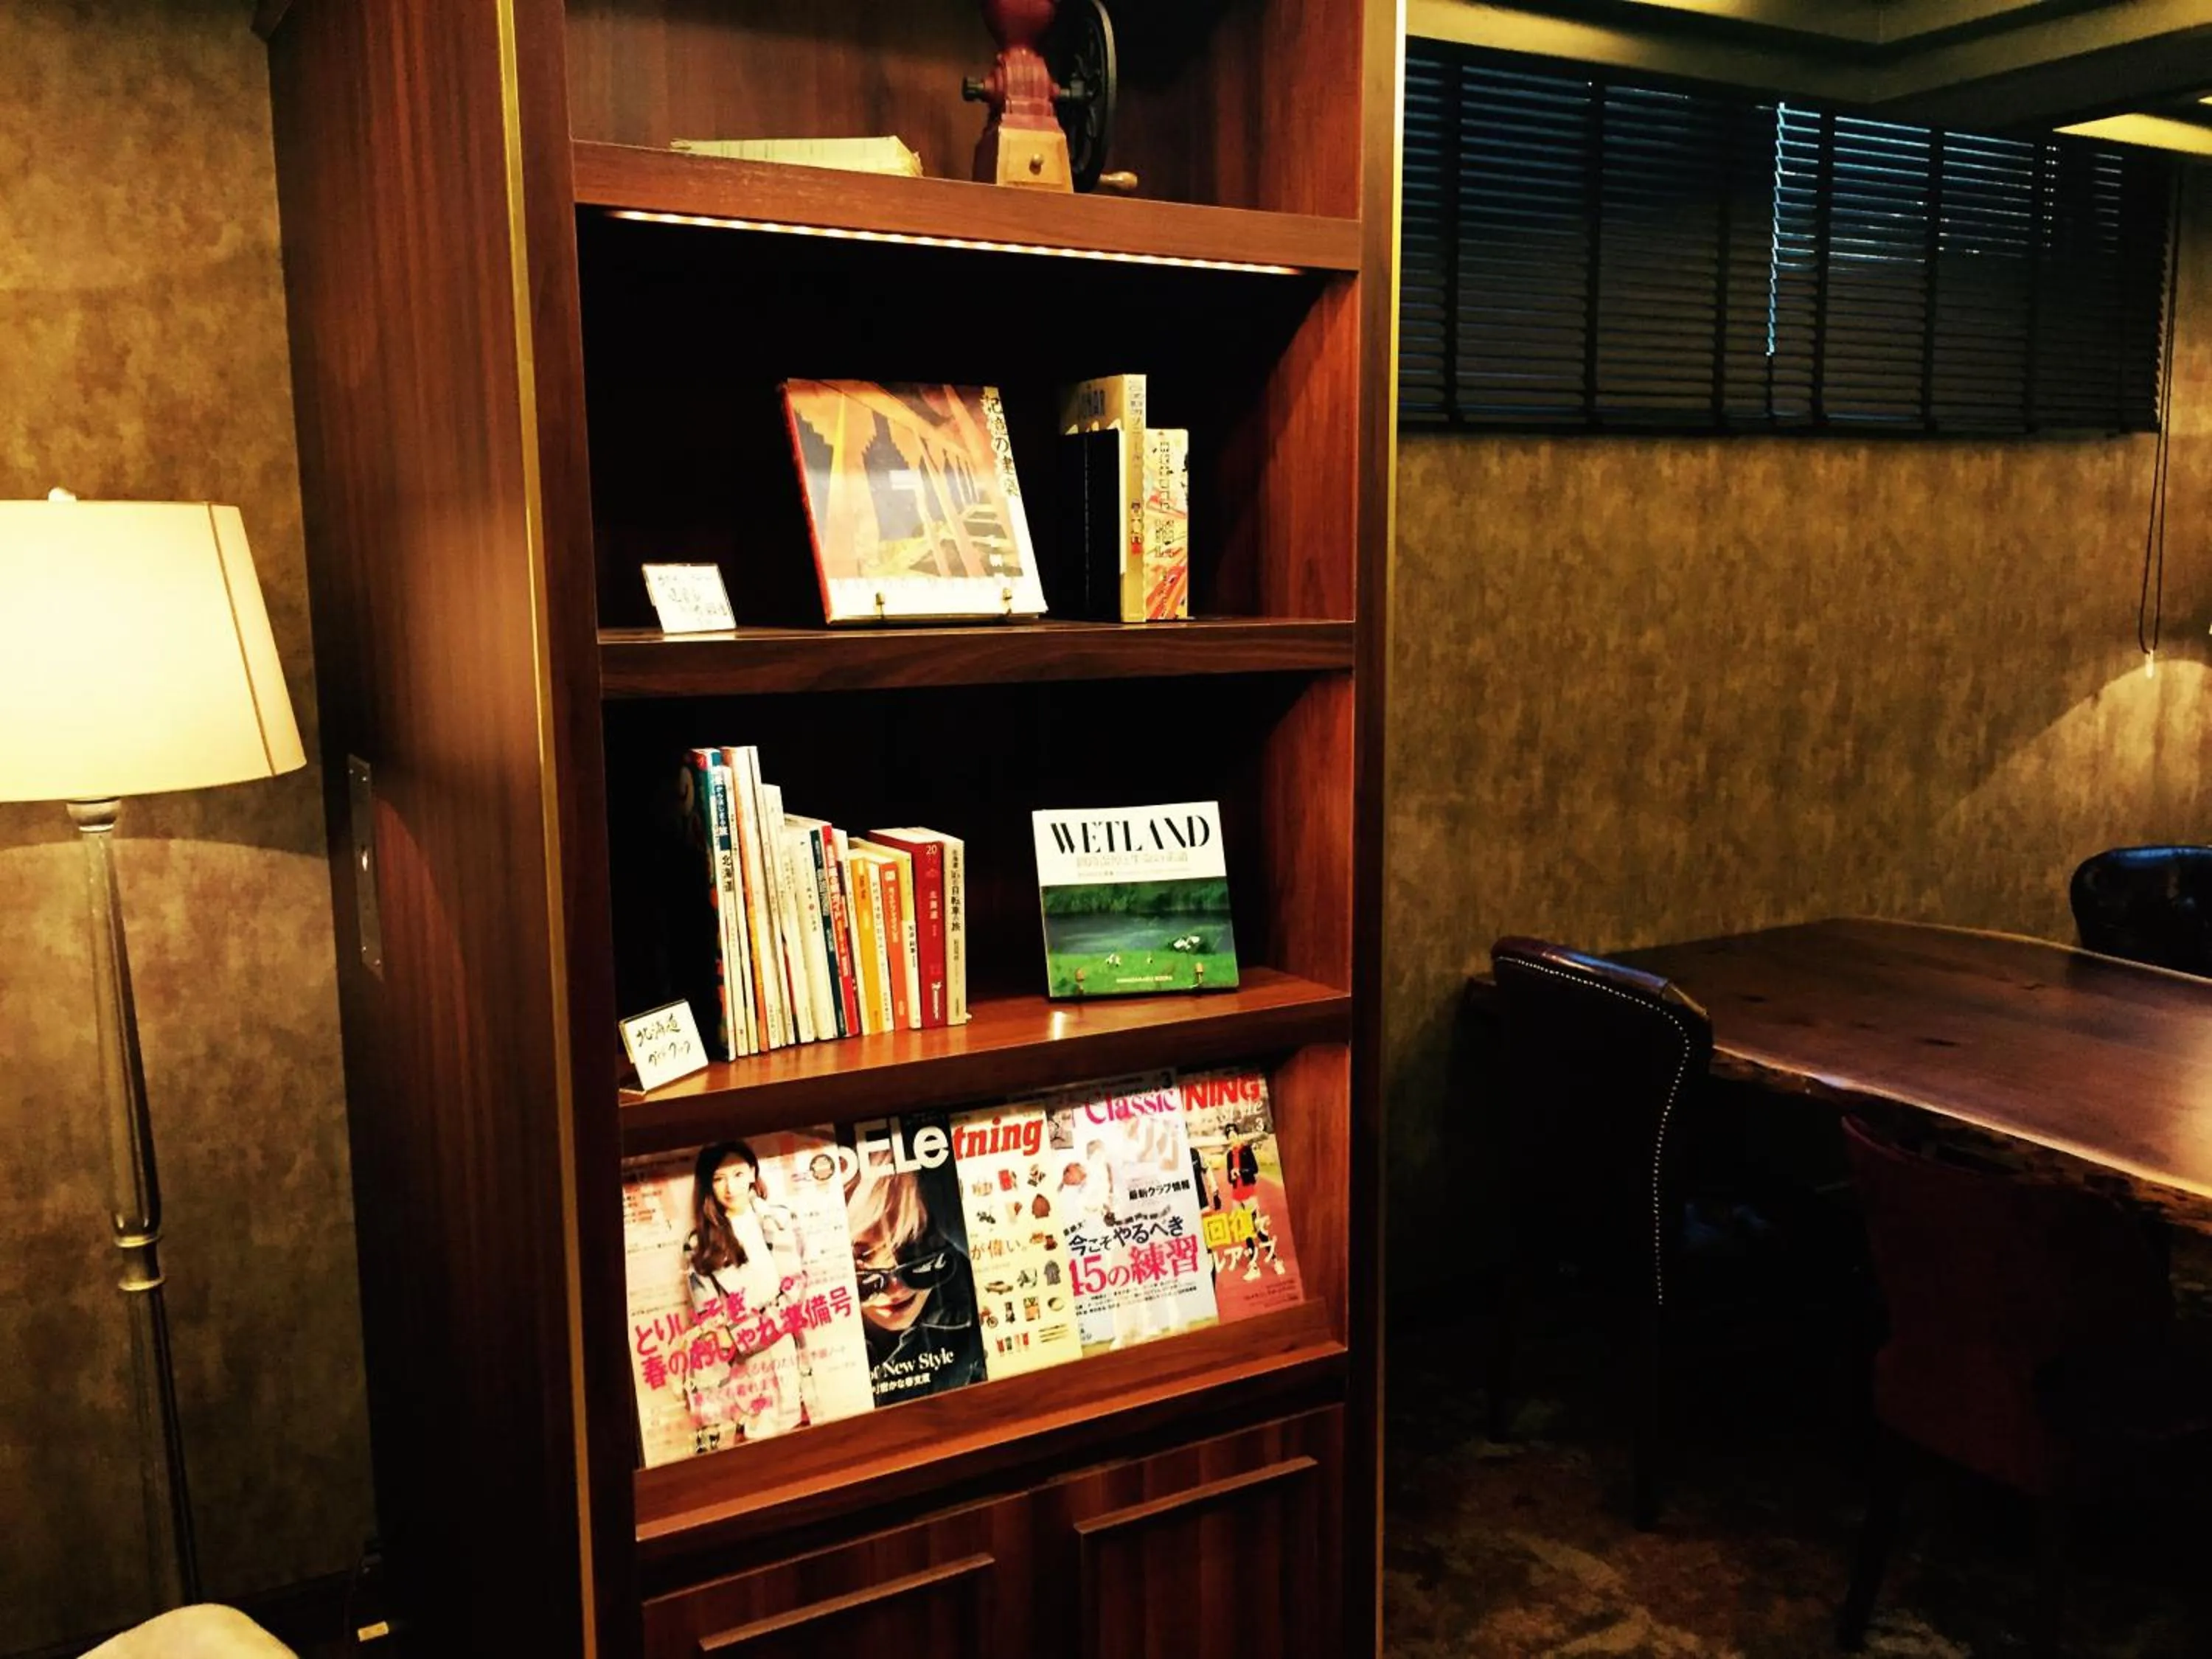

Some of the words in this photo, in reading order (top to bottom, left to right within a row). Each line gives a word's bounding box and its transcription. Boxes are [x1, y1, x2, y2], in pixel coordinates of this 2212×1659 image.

[925, 844, 937, 855] 20
[1051, 815, 1210, 854] WETLAND
[1084, 1088, 1177, 1124] Classic
[1180, 1077, 1261, 1111] NING
[883, 1360, 916, 1377] New
[918, 1347, 954, 1371] Style
